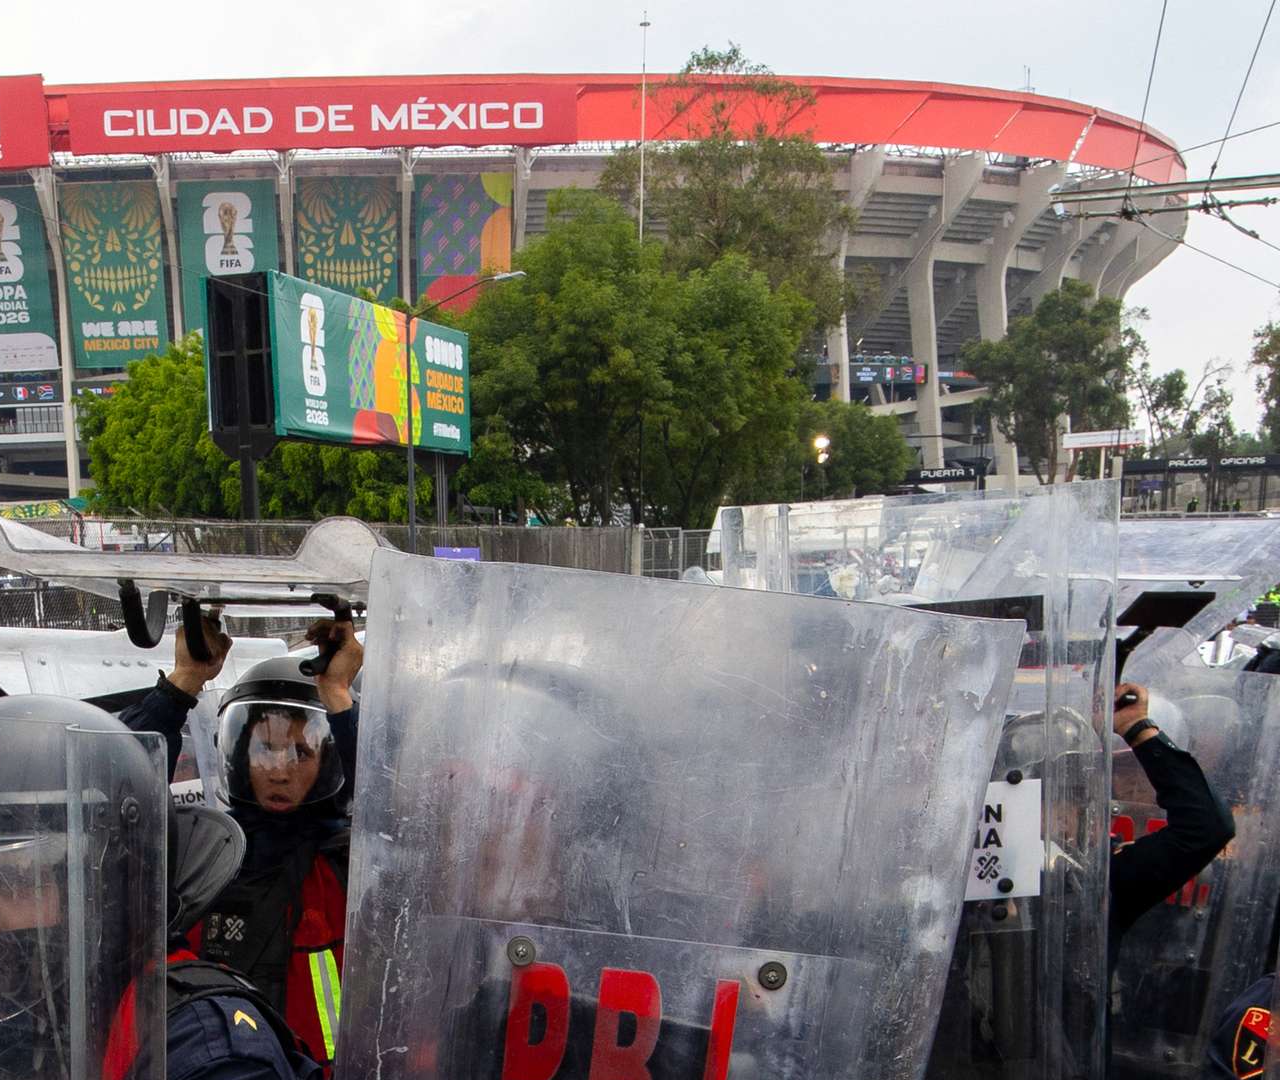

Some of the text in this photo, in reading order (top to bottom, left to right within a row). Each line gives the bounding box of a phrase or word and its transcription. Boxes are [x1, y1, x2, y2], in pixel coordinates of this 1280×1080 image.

[104, 97, 544, 137] CIUDAD DE MÉXICO
[220, 259, 242, 268] FIFA
[82, 320, 158, 337] WE ARE
[84, 336, 159, 351] MEXICO CITY
[426, 389, 465, 414] MÉXICO
[306, 409, 329, 426] 2026
[1168, 456, 1266, 468] PALCOS OFICINAS
[920, 468, 975, 478] PUERTA 1
